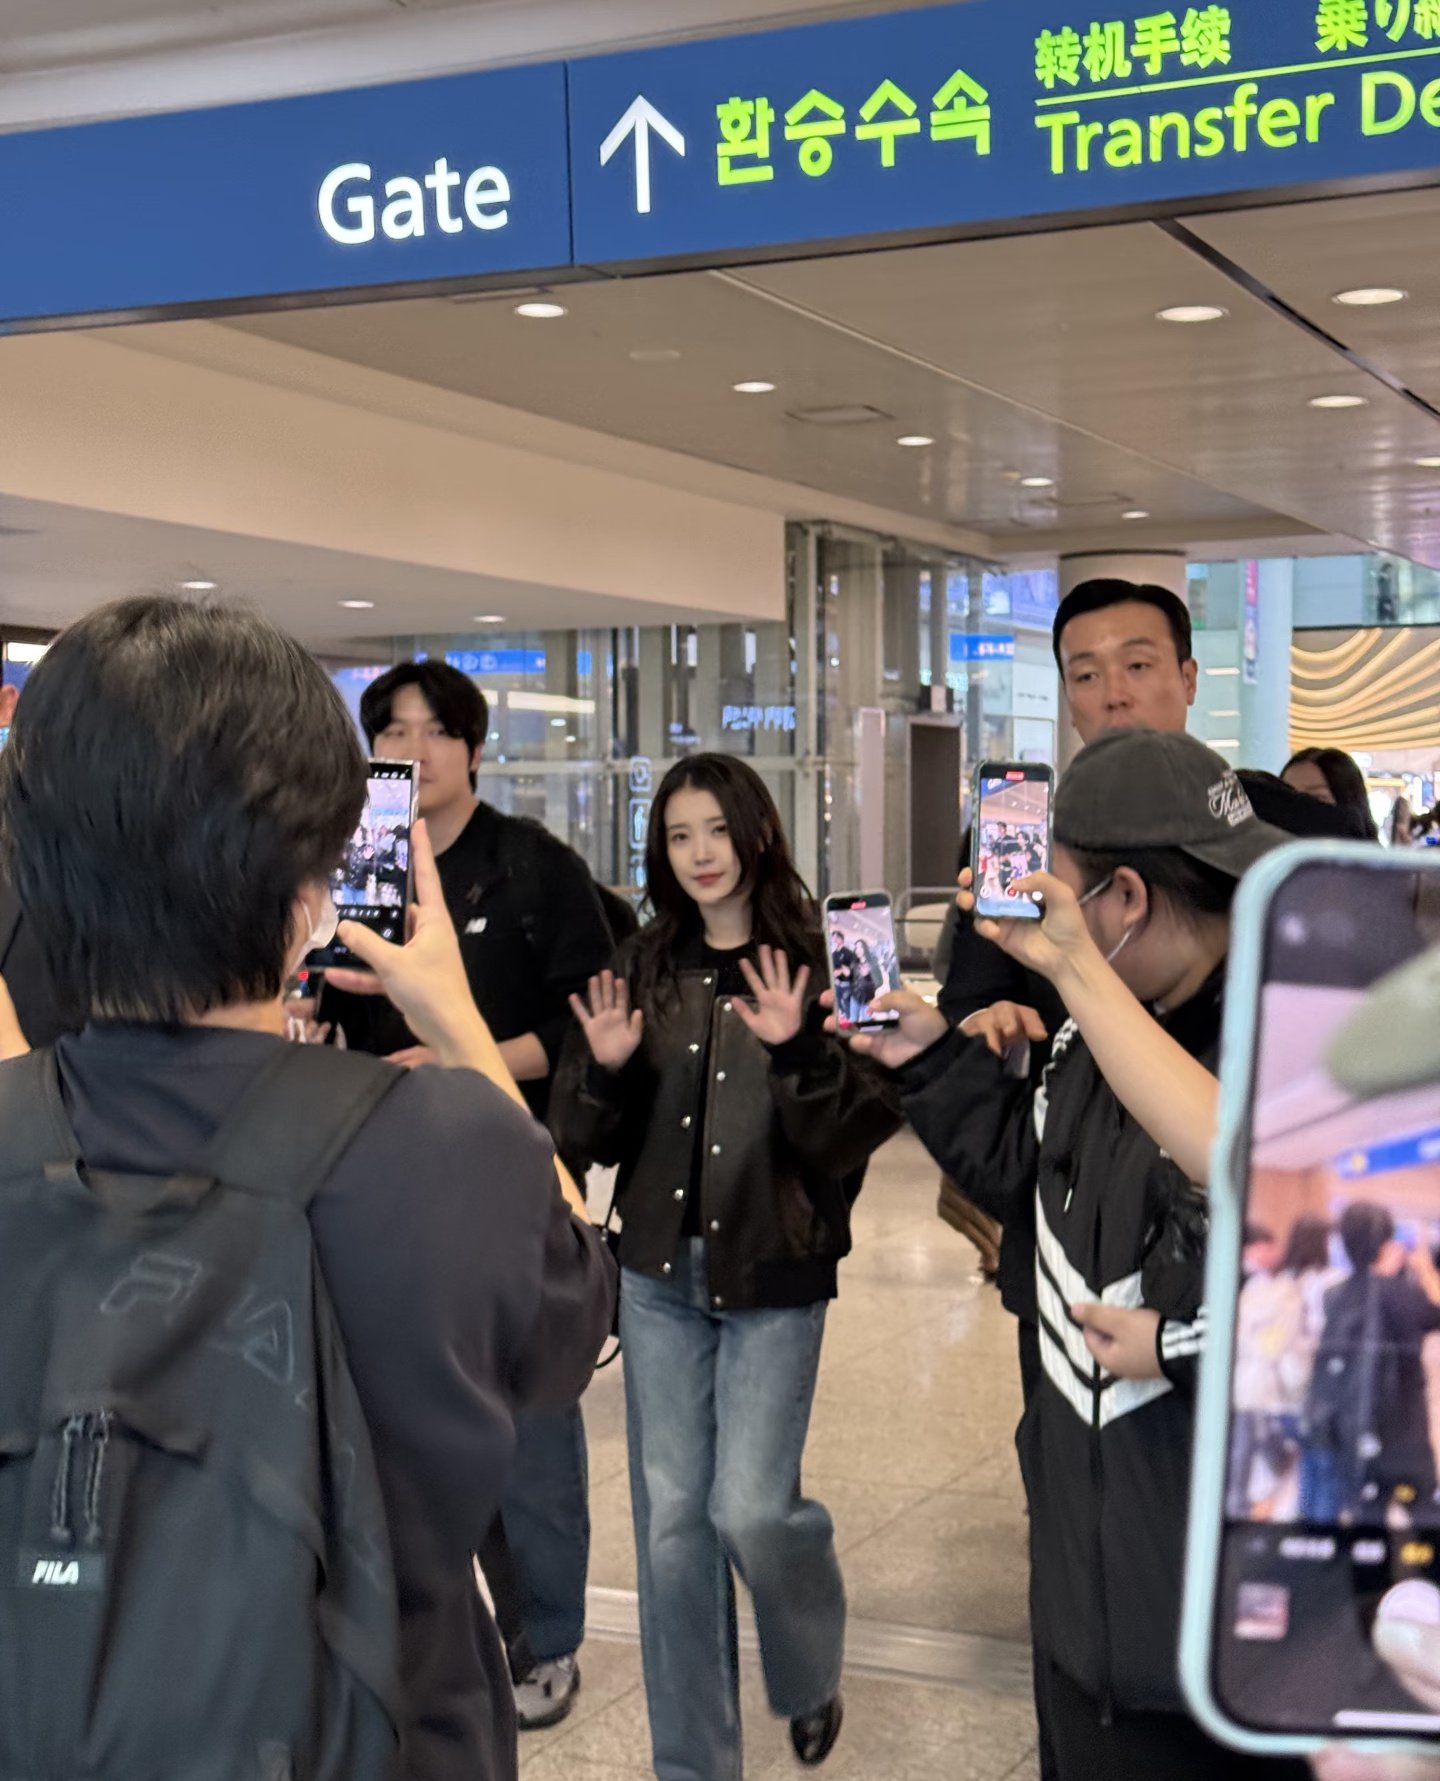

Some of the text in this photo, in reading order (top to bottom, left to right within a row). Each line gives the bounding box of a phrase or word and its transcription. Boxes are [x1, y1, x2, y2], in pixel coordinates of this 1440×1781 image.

[1034, 5, 1232, 88] 转机手续
[716, 70, 991, 186] 환승수속
[1034, 82, 1335, 175] Transfer
[318, 157, 511, 244] Gate
[32, 1559, 79, 1584] FILA
